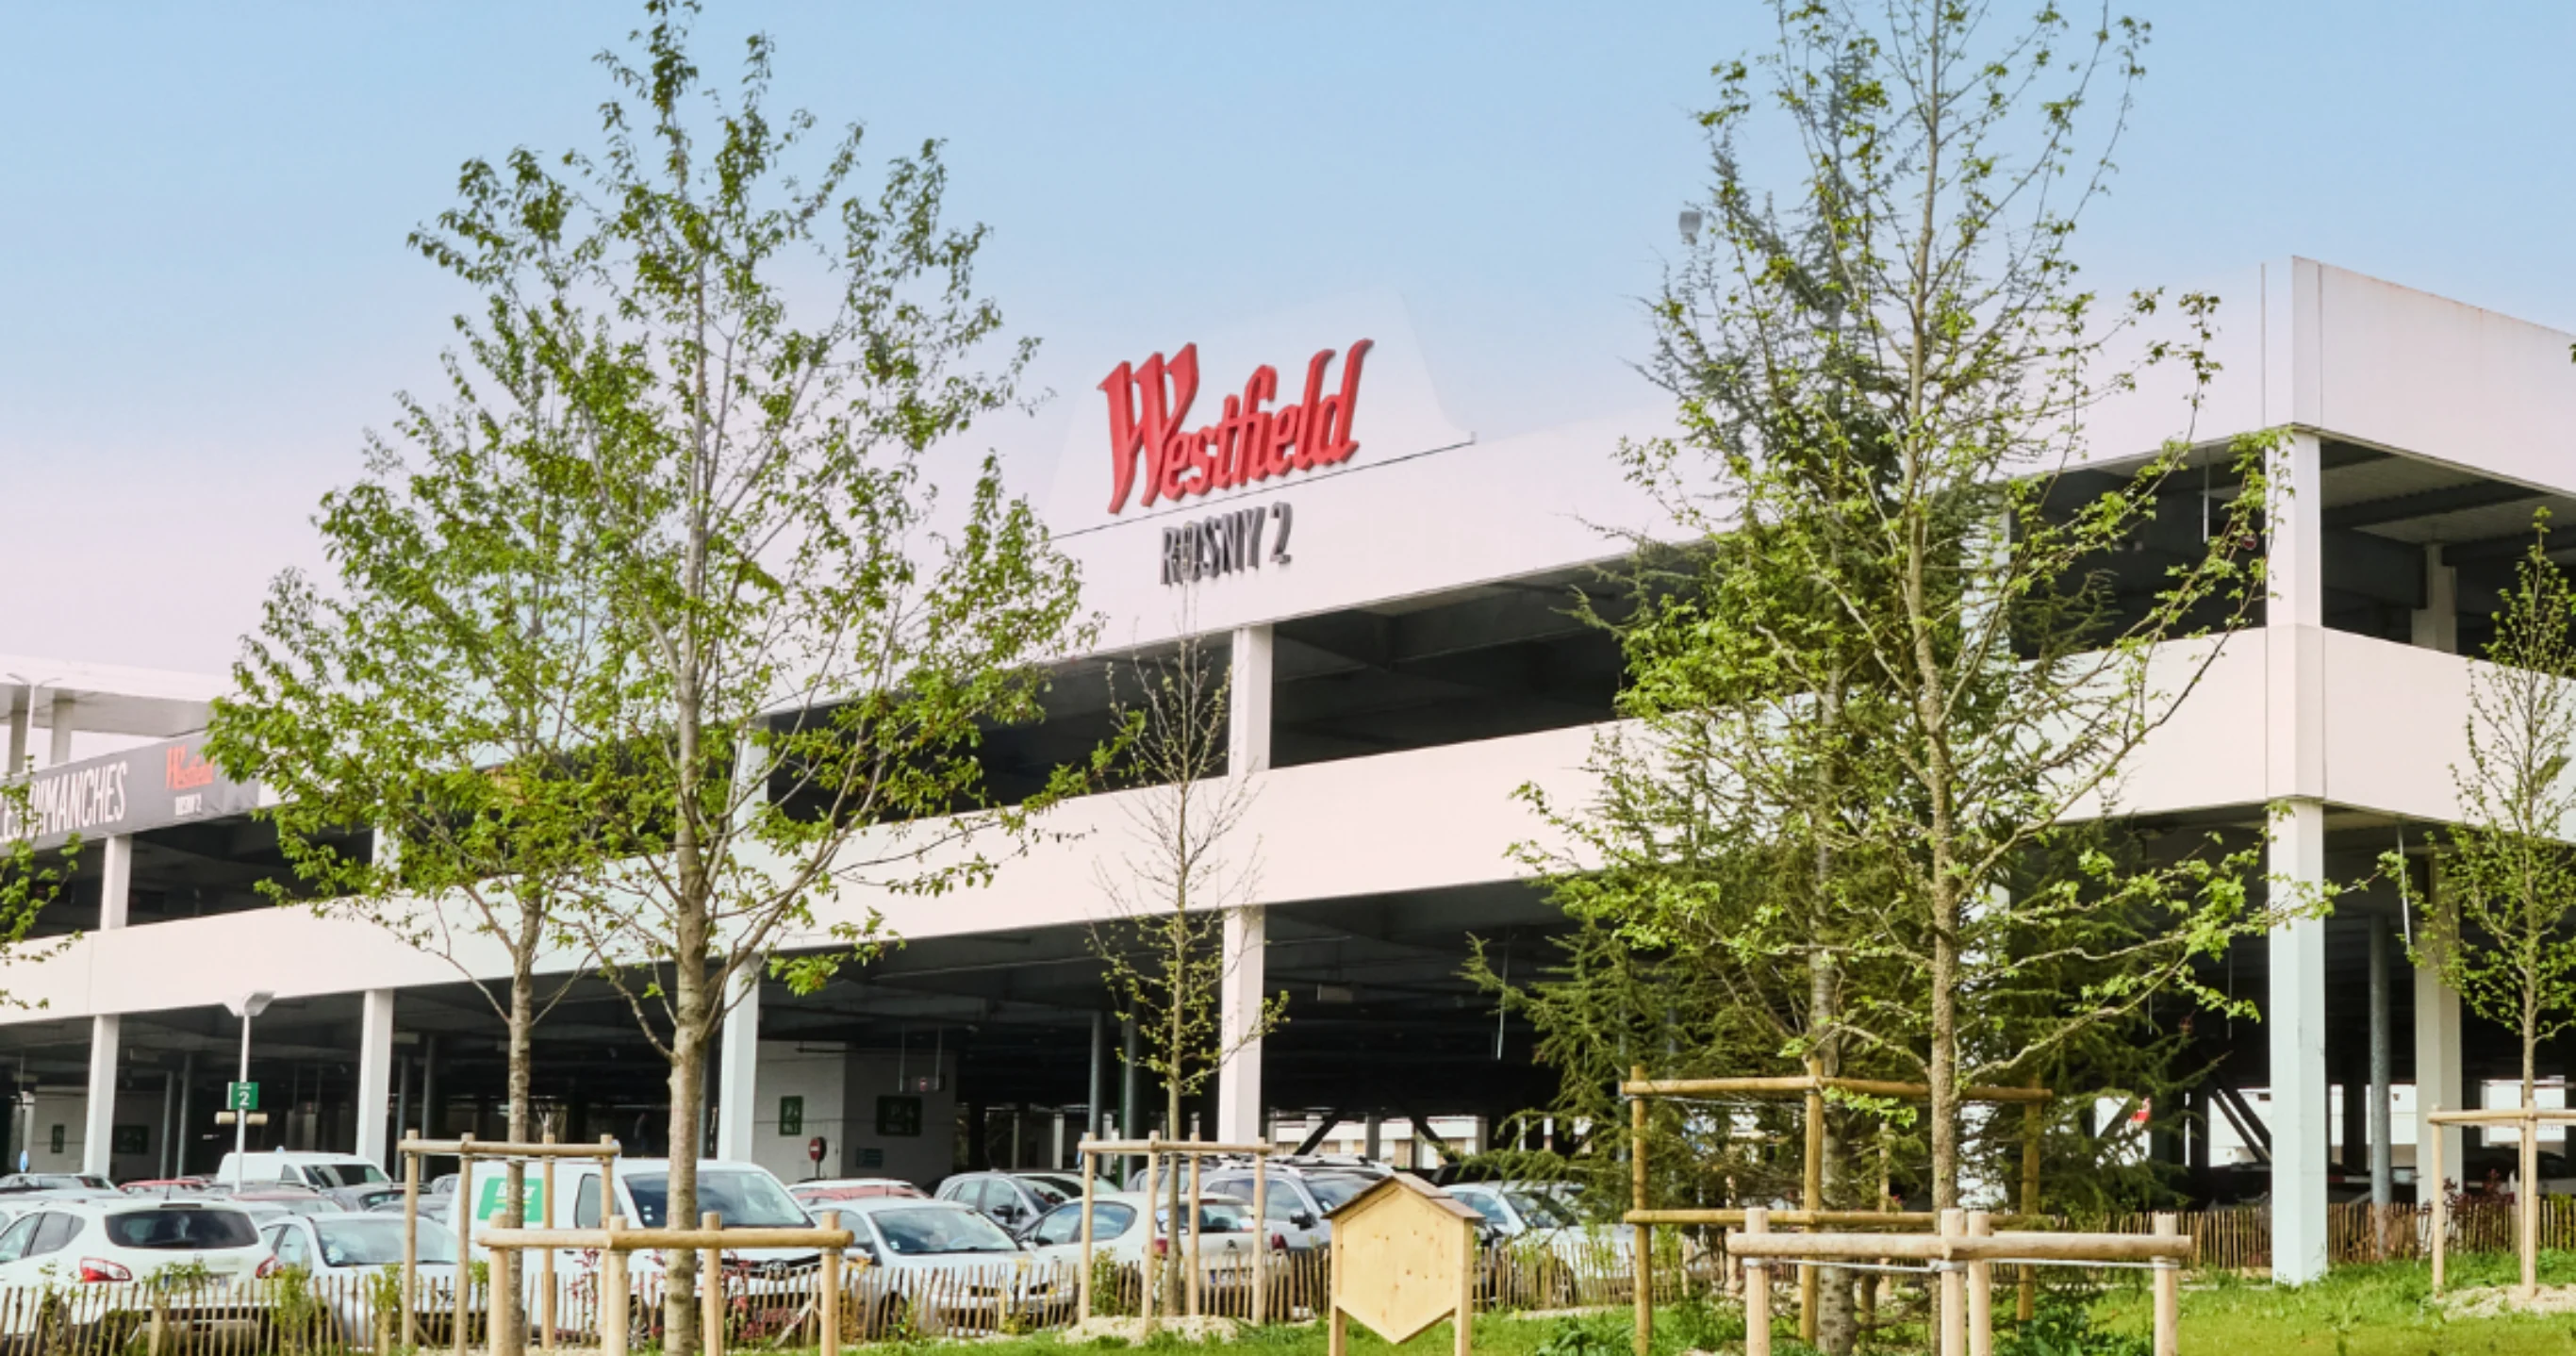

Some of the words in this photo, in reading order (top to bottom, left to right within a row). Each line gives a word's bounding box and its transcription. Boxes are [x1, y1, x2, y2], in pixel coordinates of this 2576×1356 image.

[1097, 338, 1375, 515] Westfield
[1160, 506, 1267, 587] ROSNY
[1269, 500, 1293, 566] 2
[26, 760, 128, 839] DIMANCHES
[239, 1091, 250, 1106] 2
